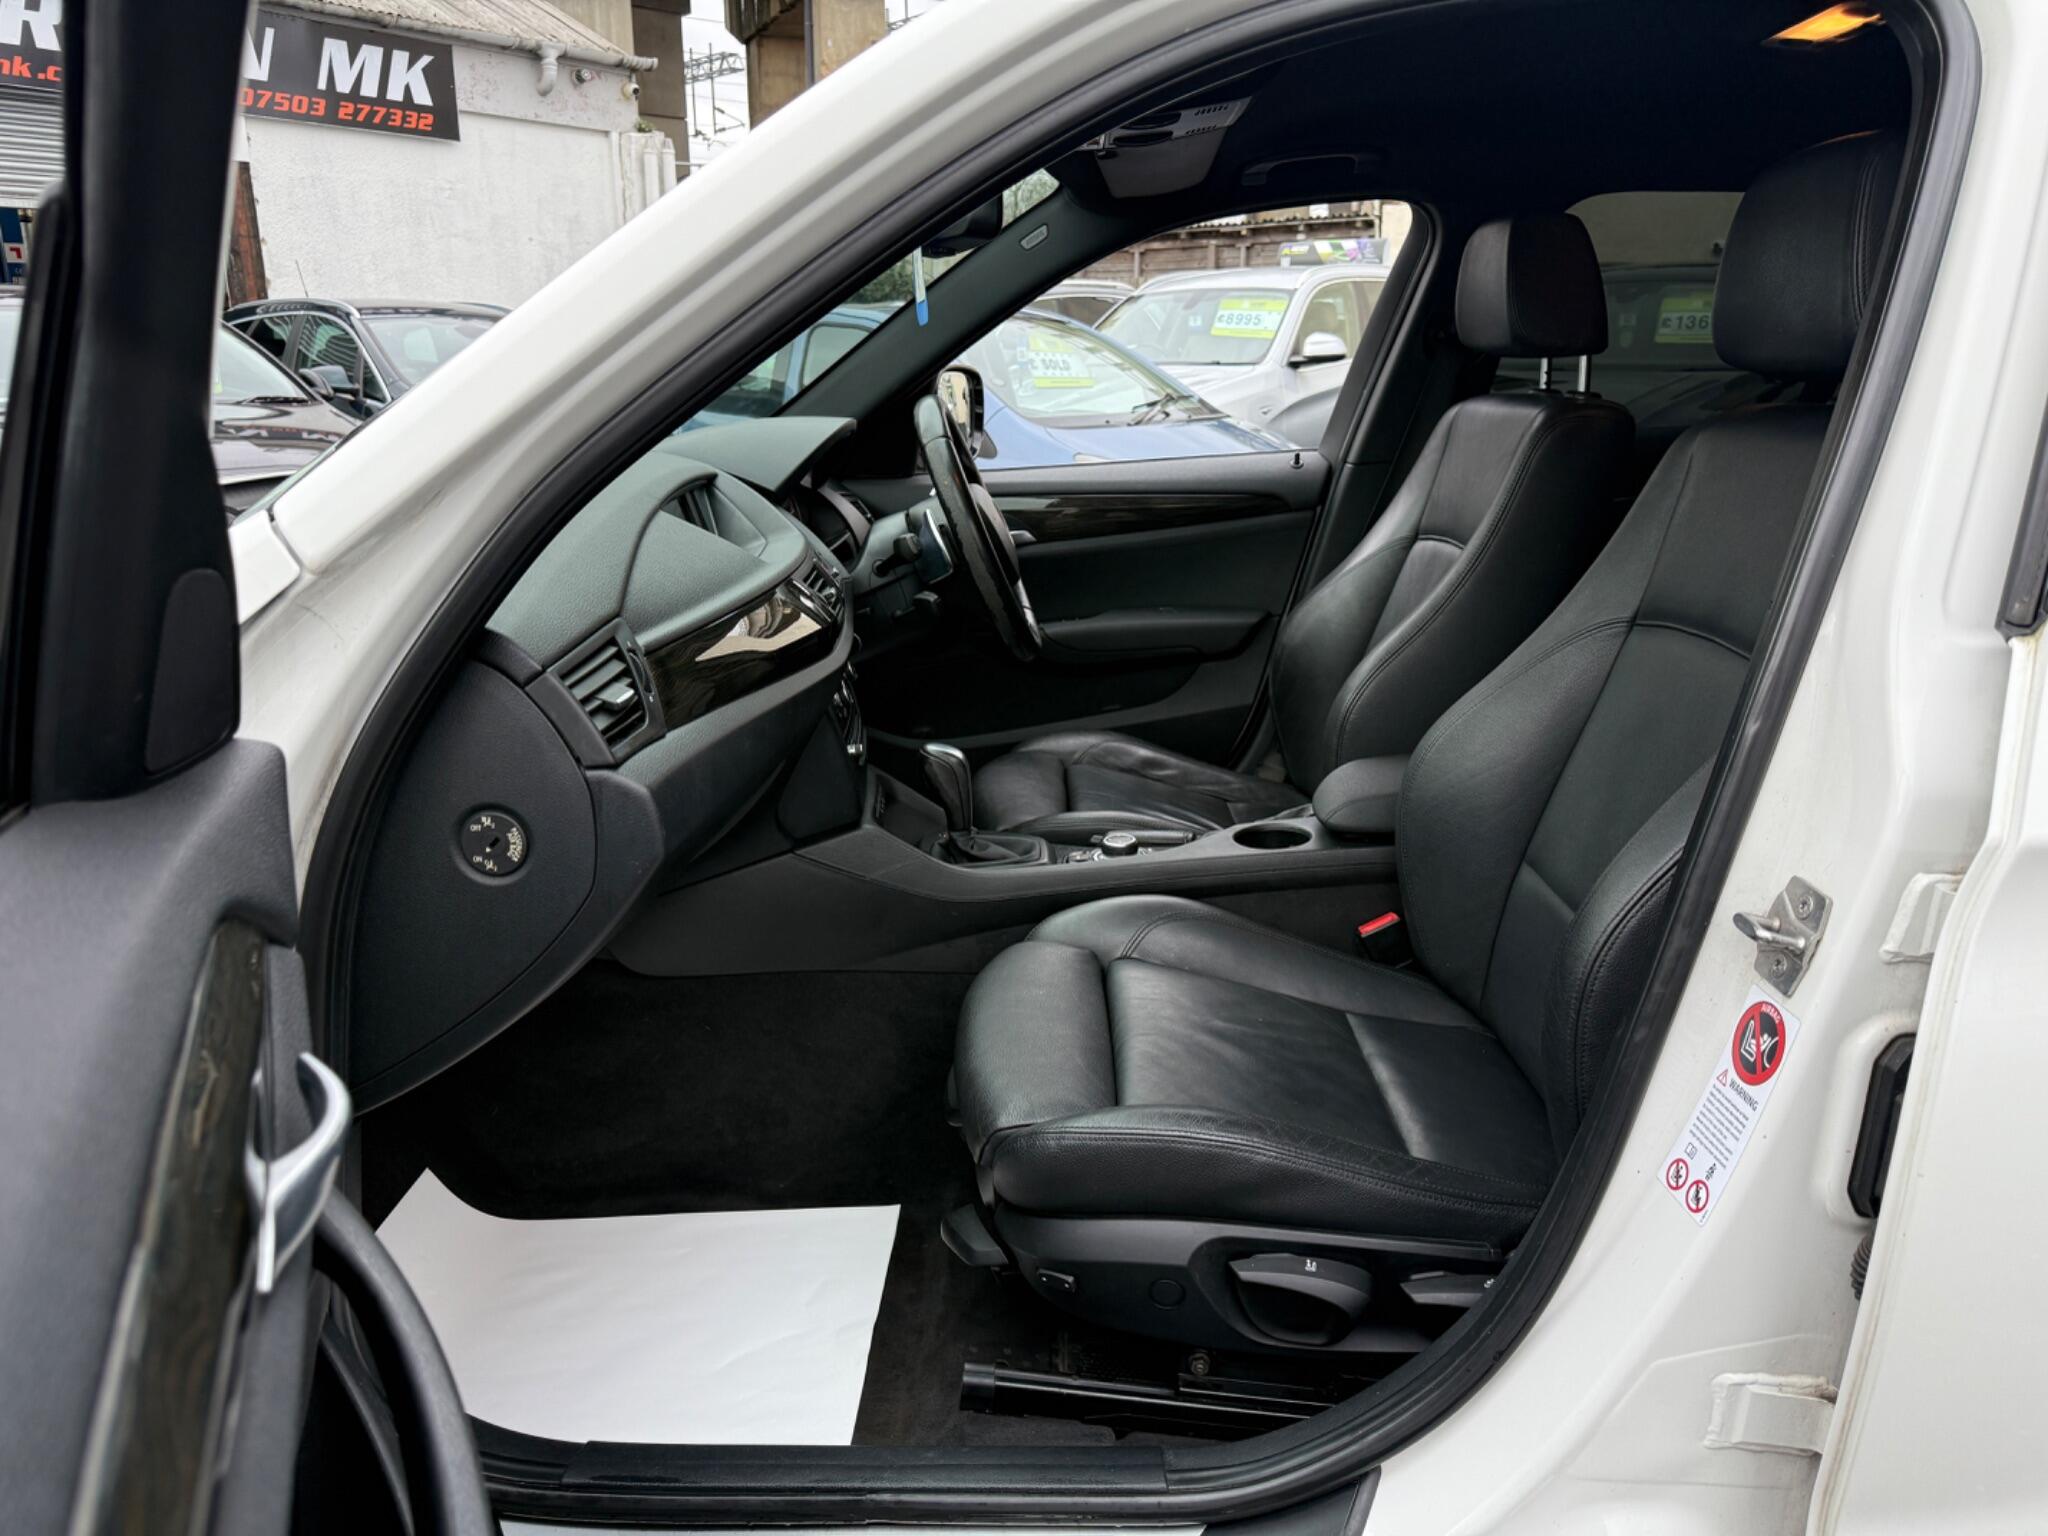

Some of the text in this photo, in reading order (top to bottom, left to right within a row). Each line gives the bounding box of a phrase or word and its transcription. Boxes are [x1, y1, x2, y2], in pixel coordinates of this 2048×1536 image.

[0, 0, 63, 51] R
[317, 37, 434, 106] MK
[239, 88, 326, 116] 07503
[338, 101, 434, 130] 277332
[1729, 1079, 1758, 1112] WARNING
